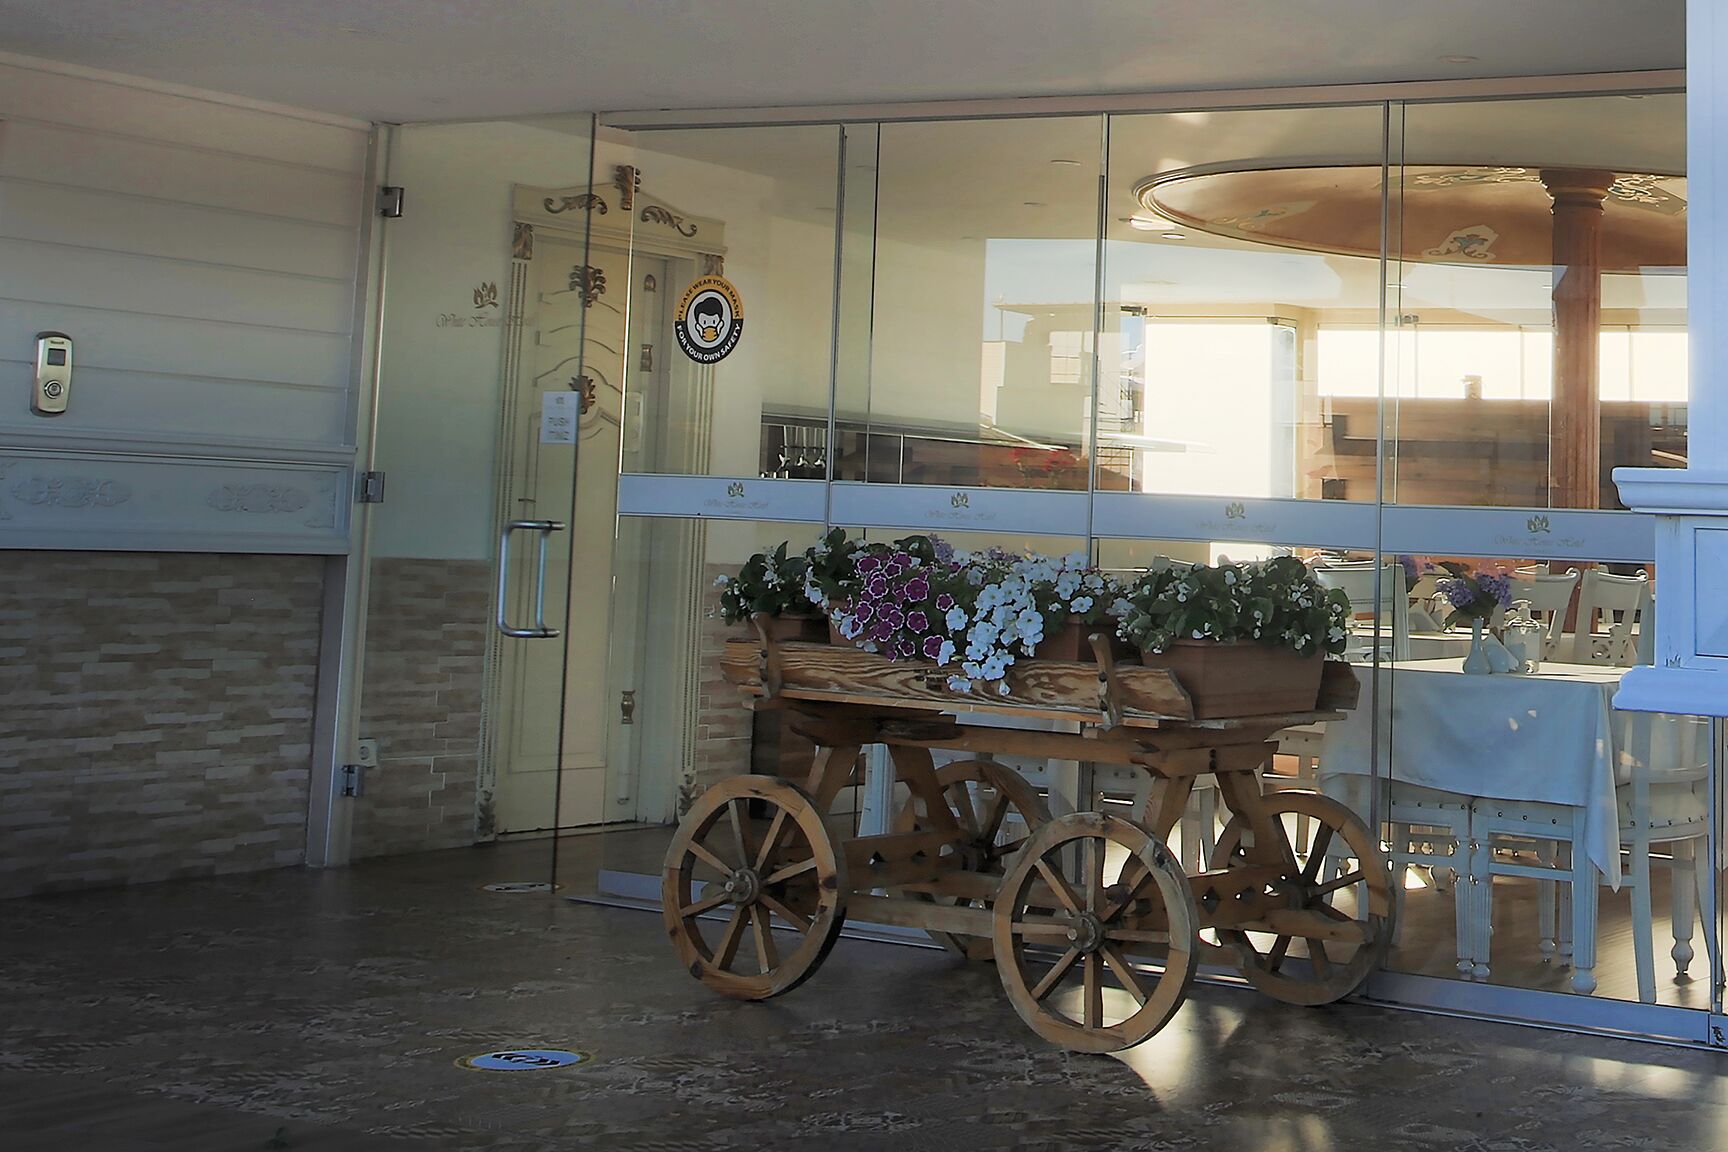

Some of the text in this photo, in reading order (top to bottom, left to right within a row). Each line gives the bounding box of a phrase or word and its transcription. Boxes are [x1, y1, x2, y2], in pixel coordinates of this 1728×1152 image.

[678, 278, 741, 320] PLEASE WEAR YOUR MASK
[677, 323, 741, 362] FOR YOUR OWN SAFETY
